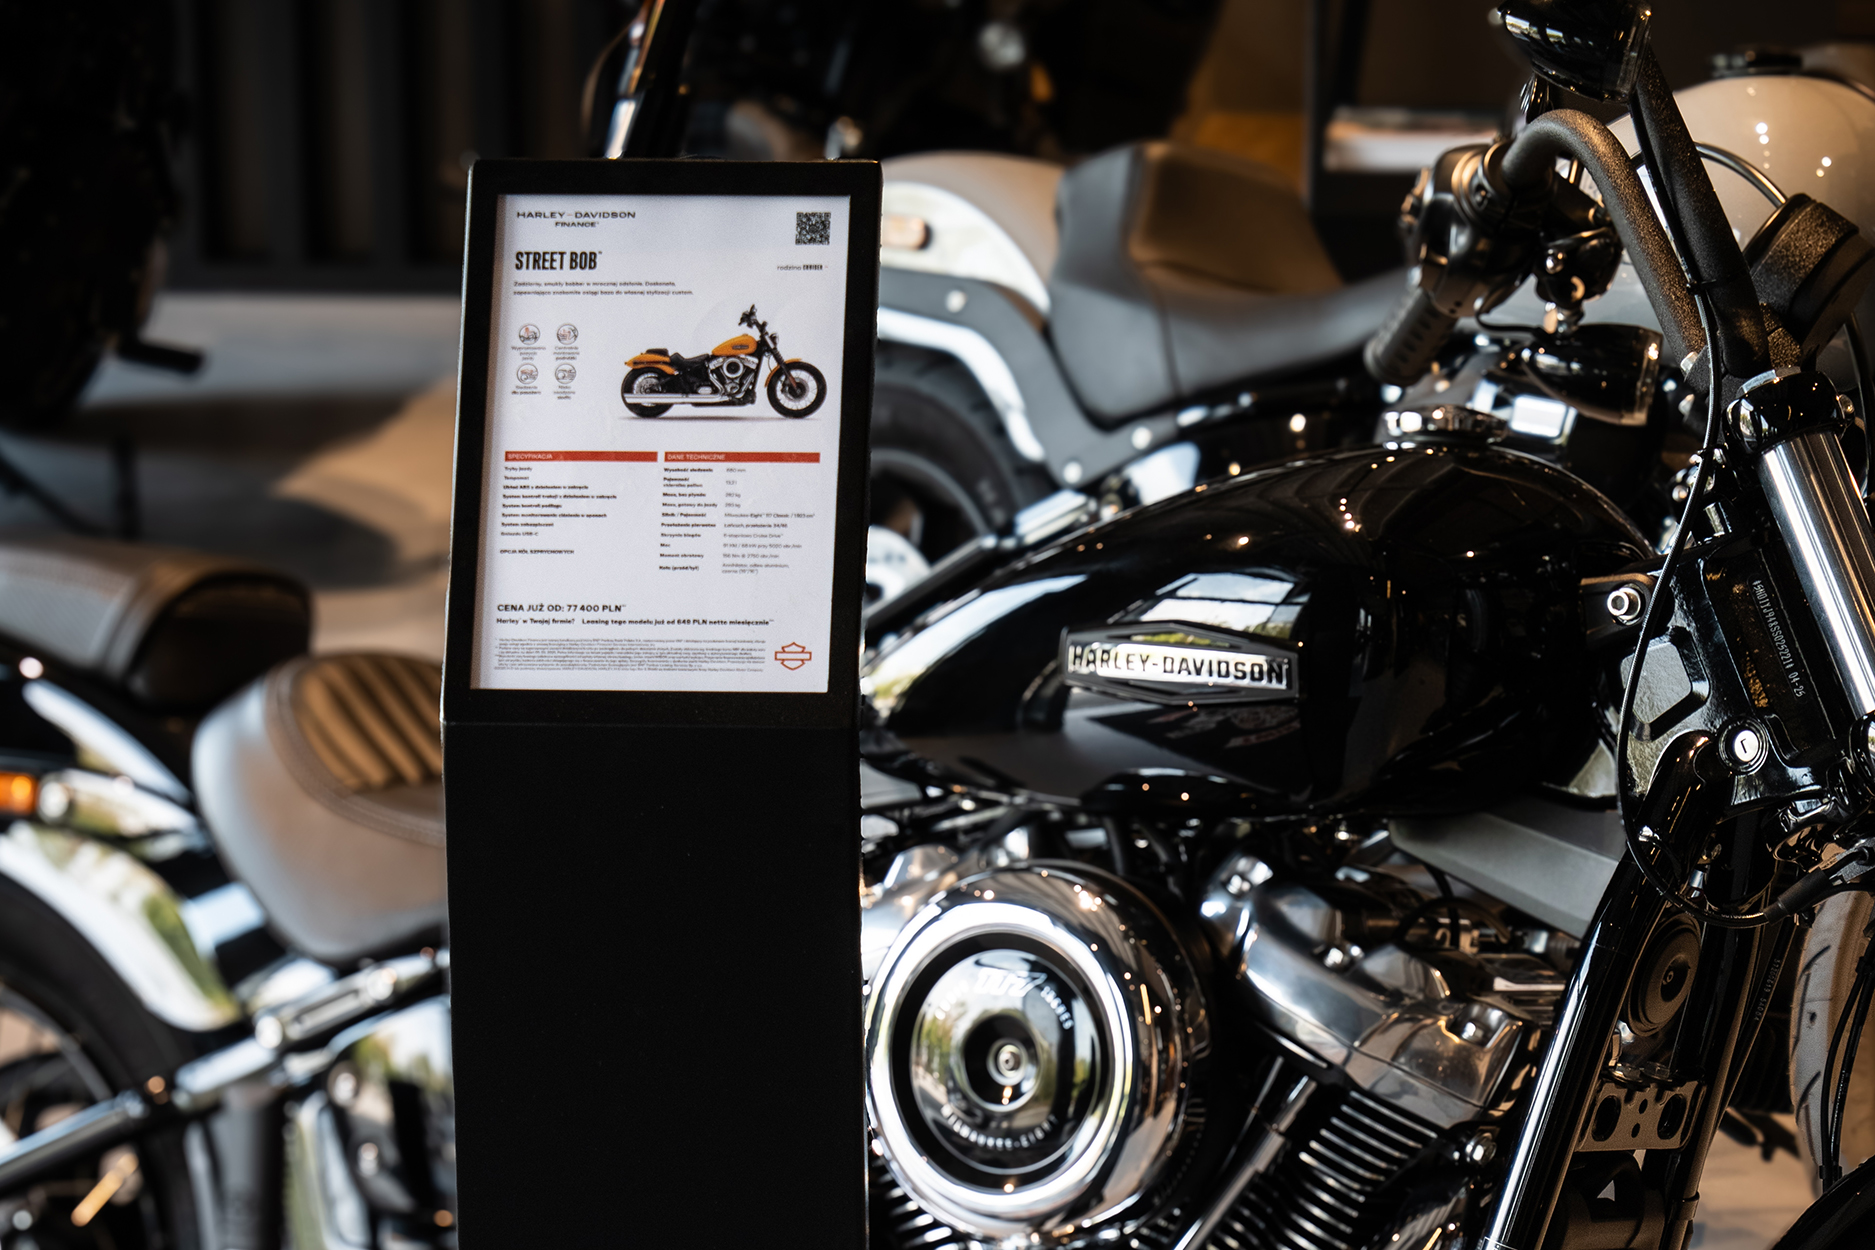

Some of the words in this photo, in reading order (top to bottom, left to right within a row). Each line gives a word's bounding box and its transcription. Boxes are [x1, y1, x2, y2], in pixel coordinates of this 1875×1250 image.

[514, 251, 567, 271] STREET
[569, 251, 598, 271] BOB
[498, 604, 524, 612] CENA
[526, 604, 545, 612] JUŻ
[547, 604, 564, 612] OD:
[566, 604, 578, 612] 77
[580, 604, 600, 612] 400
[1068, 645, 1288, 686] HARLEY-DAVIDSON
[1788, 672, 1806, 698] 04-25
[1040, 985, 1075, 1030] INCHES
